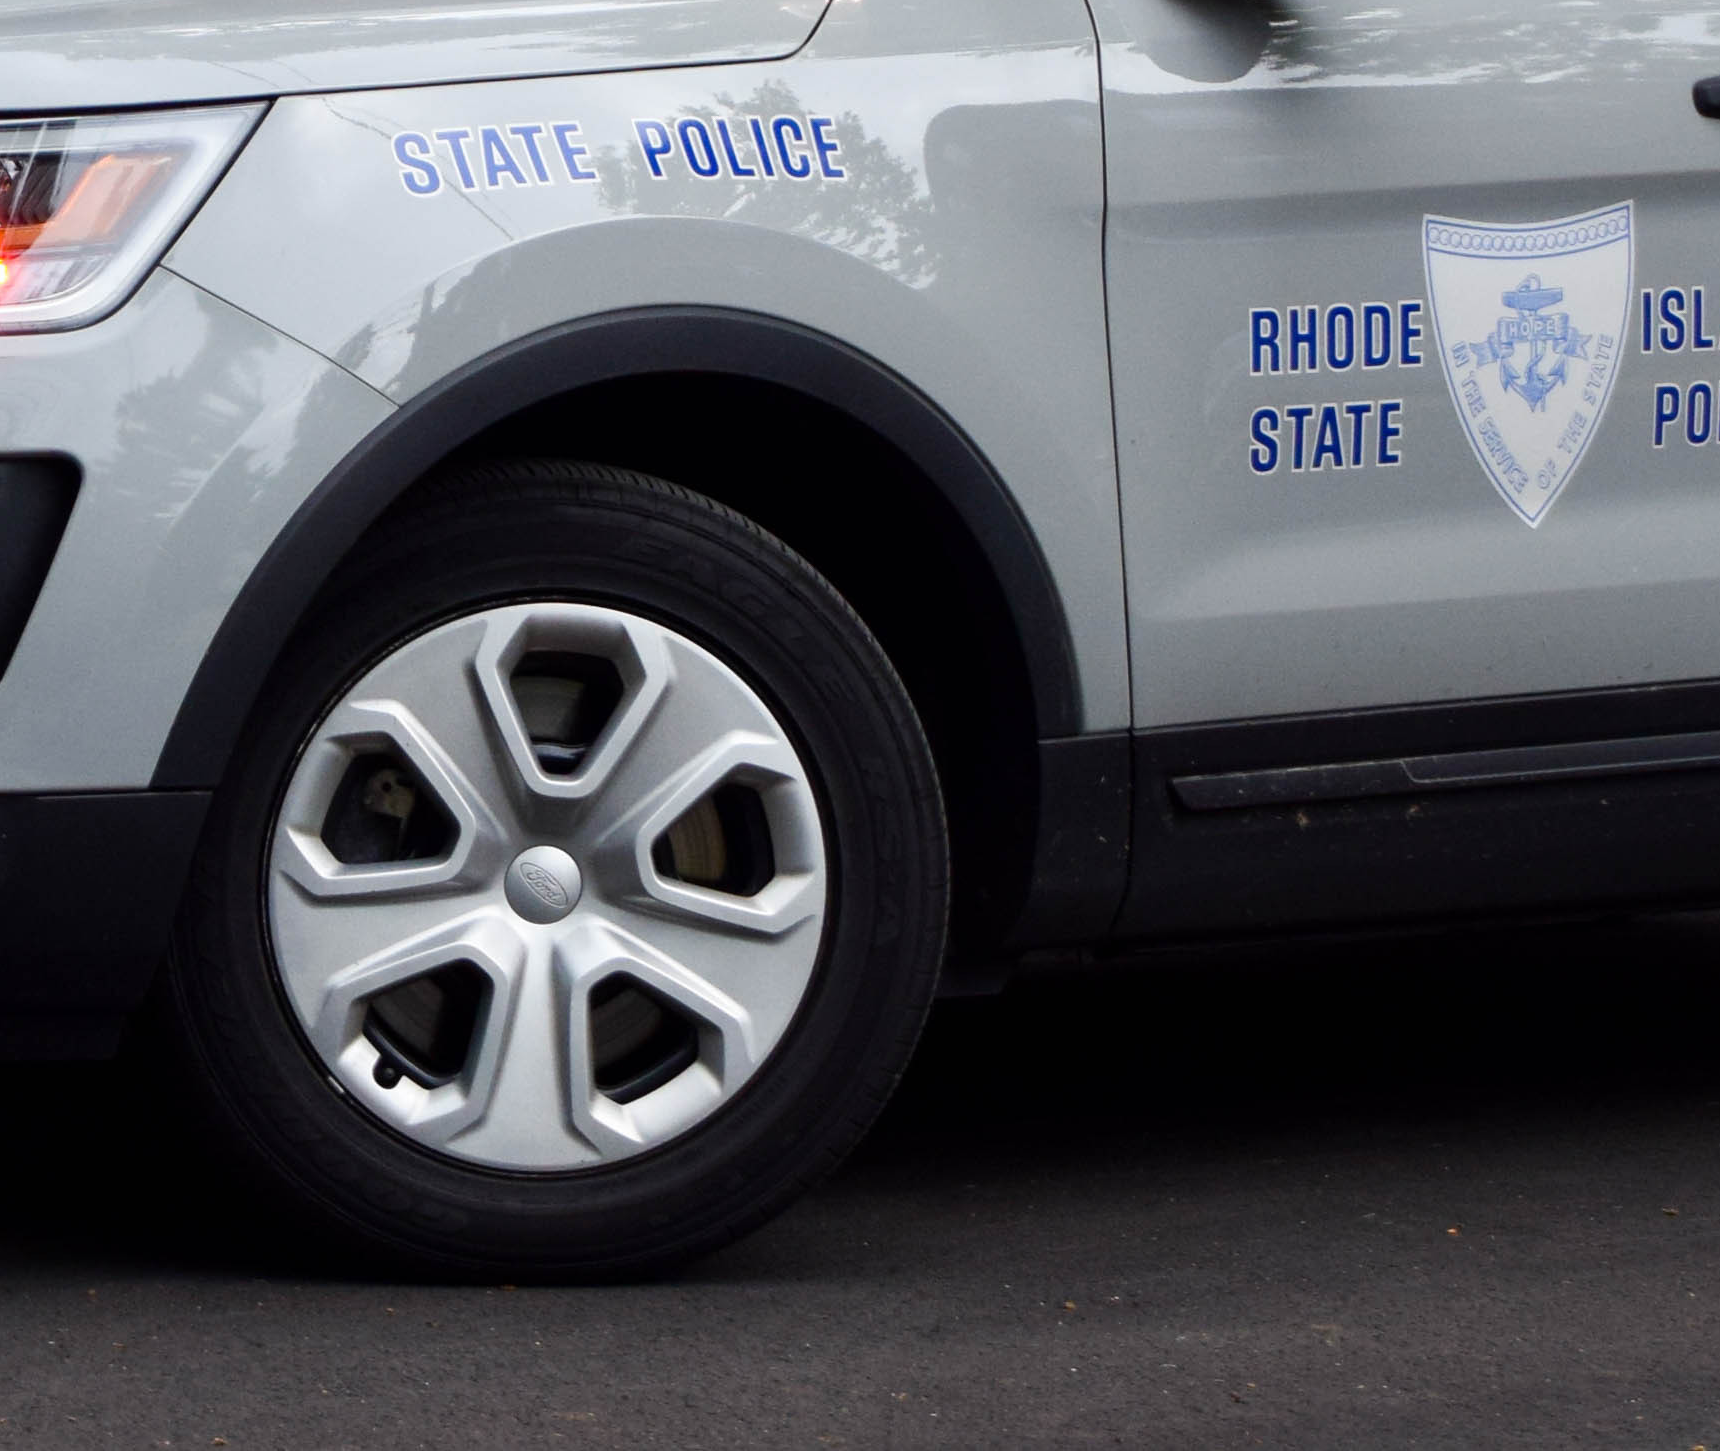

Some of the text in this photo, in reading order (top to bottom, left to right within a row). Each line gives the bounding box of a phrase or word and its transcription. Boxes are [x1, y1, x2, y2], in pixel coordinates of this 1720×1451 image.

[390, 113, 849, 199] STATE POLICE
[1249, 299, 1423, 376] RHODE
[1510, 318, 1555, 339] HOPE
[1249, 398, 1403, 475] STATE
[1451, 333, 1614, 494] IN THE SERVICE OF THE STATE
[526, 869, 560, 900] Ford
